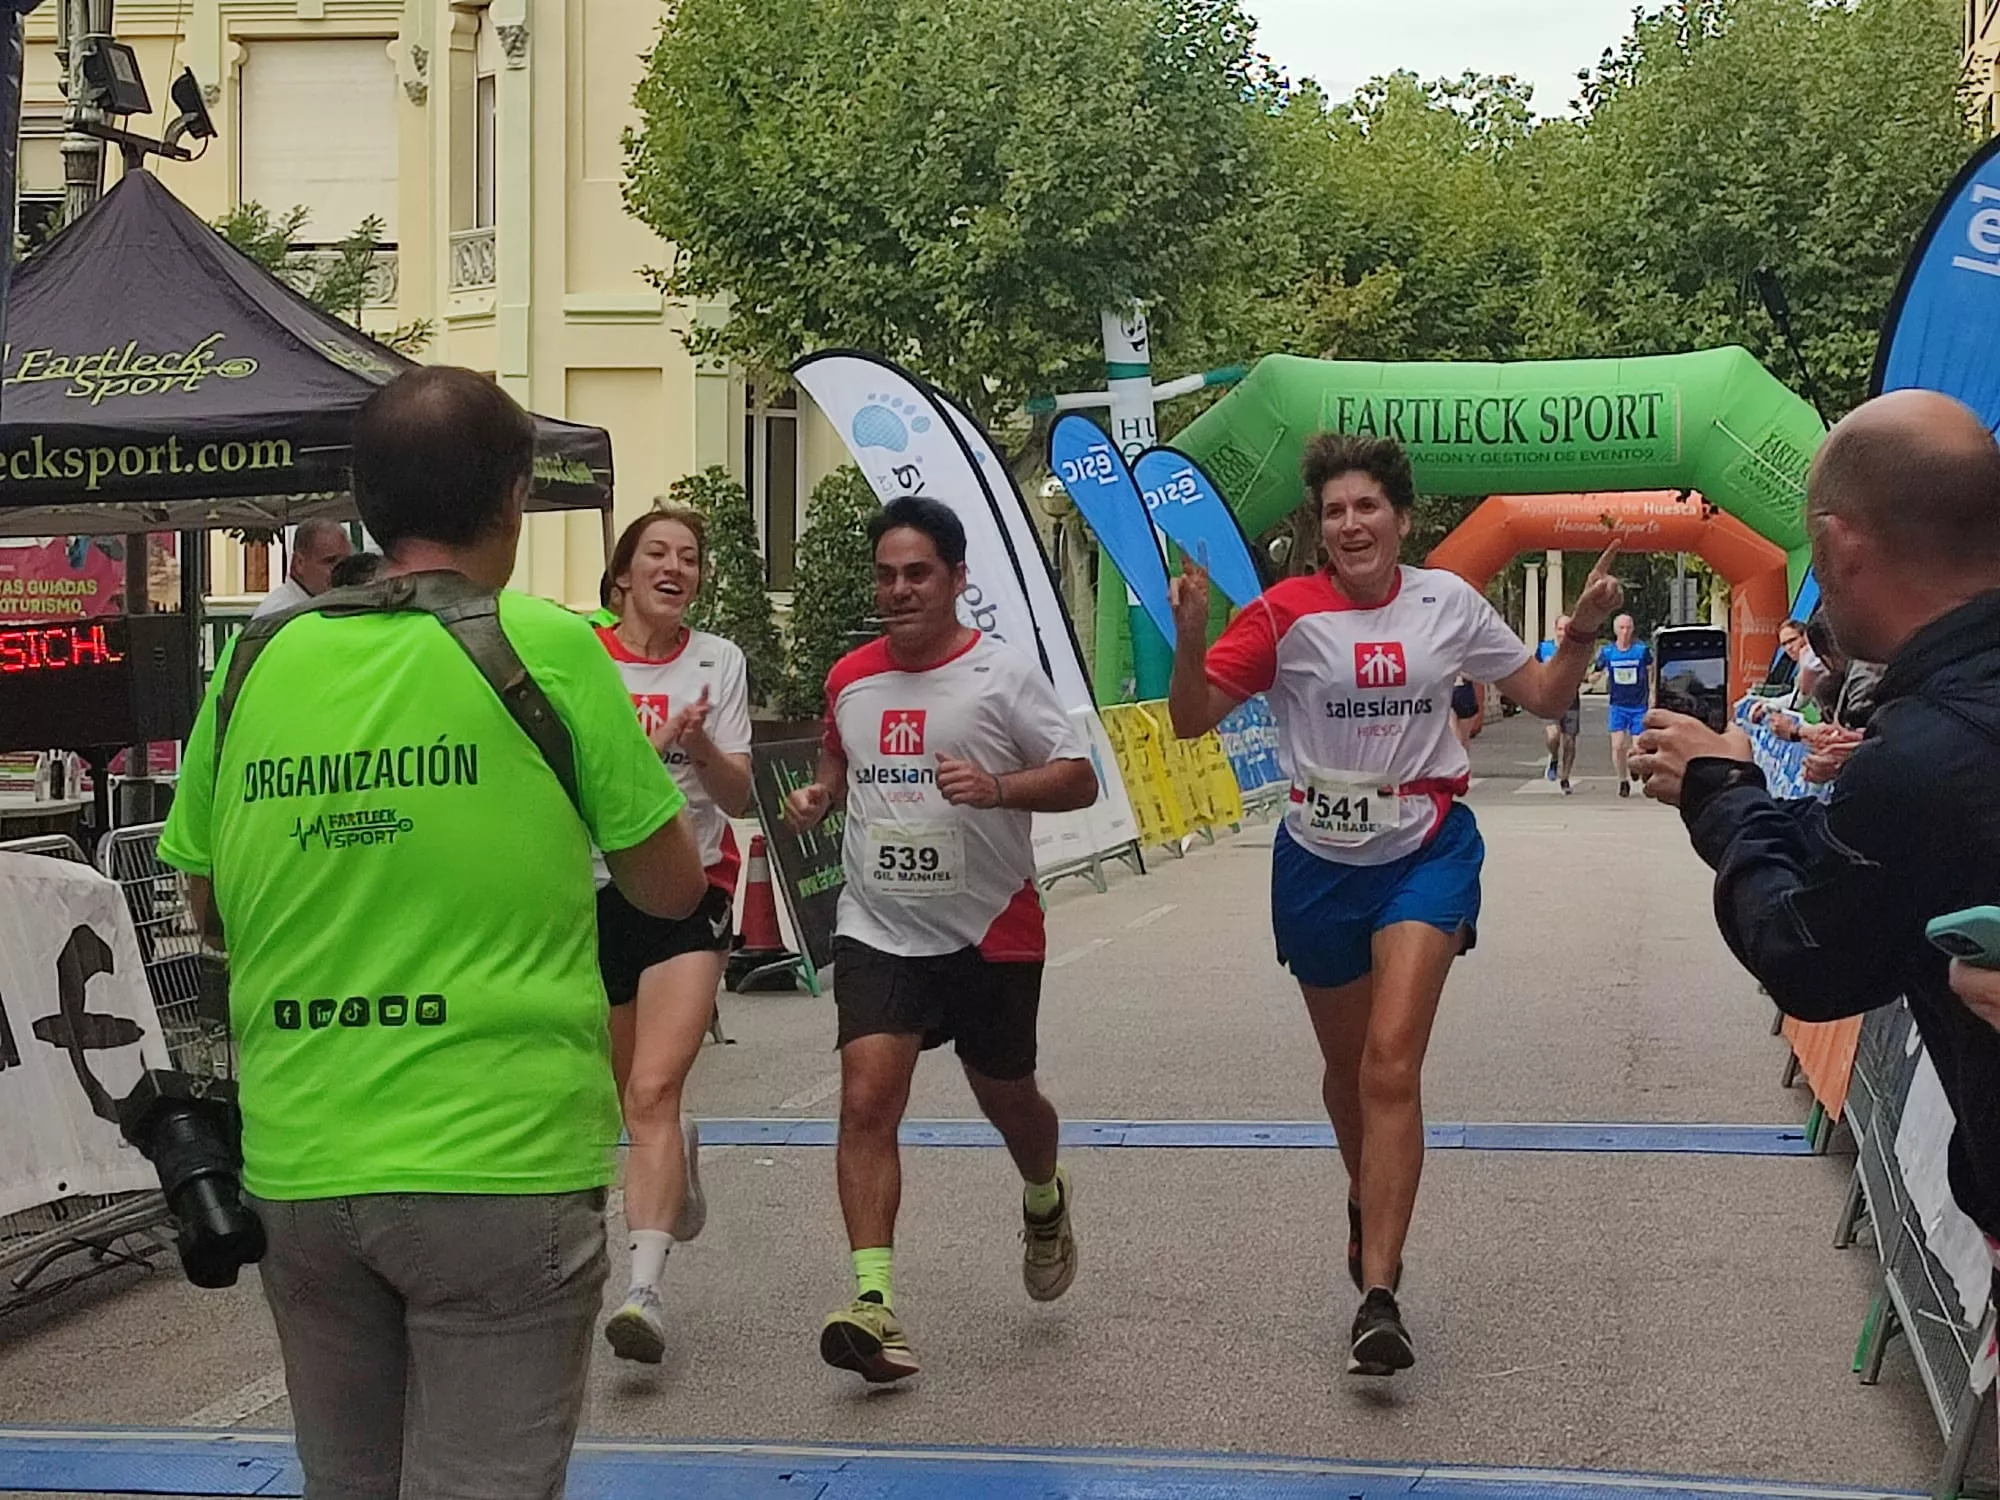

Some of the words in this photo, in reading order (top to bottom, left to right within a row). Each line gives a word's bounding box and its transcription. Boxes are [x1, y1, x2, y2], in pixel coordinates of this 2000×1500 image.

[65, 373, 202, 406] Sport
[1538, 392, 1665, 444] SPORT
[1467, 452, 1477, 463] Y
[1480, 450, 1551, 464] GESTION
[1554, 450, 1577, 462] DE
[1580, 448, 1655, 462] EVENTOS
[1622, 502, 1640, 515] de
[1643, 502, 1698, 516] Huesca
[27, 578, 97, 595] GUIADAS
[1326, 697, 1433, 719] salesianos
[243, 733, 478, 804] ORGANIZACIÓN
[856, 764, 934, 785] salesian
[1314, 792, 1369, 823] 541
[334, 829, 398, 848] SPORT
[878, 845, 940, 872] 539
[873, 871, 894, 882] GIL
